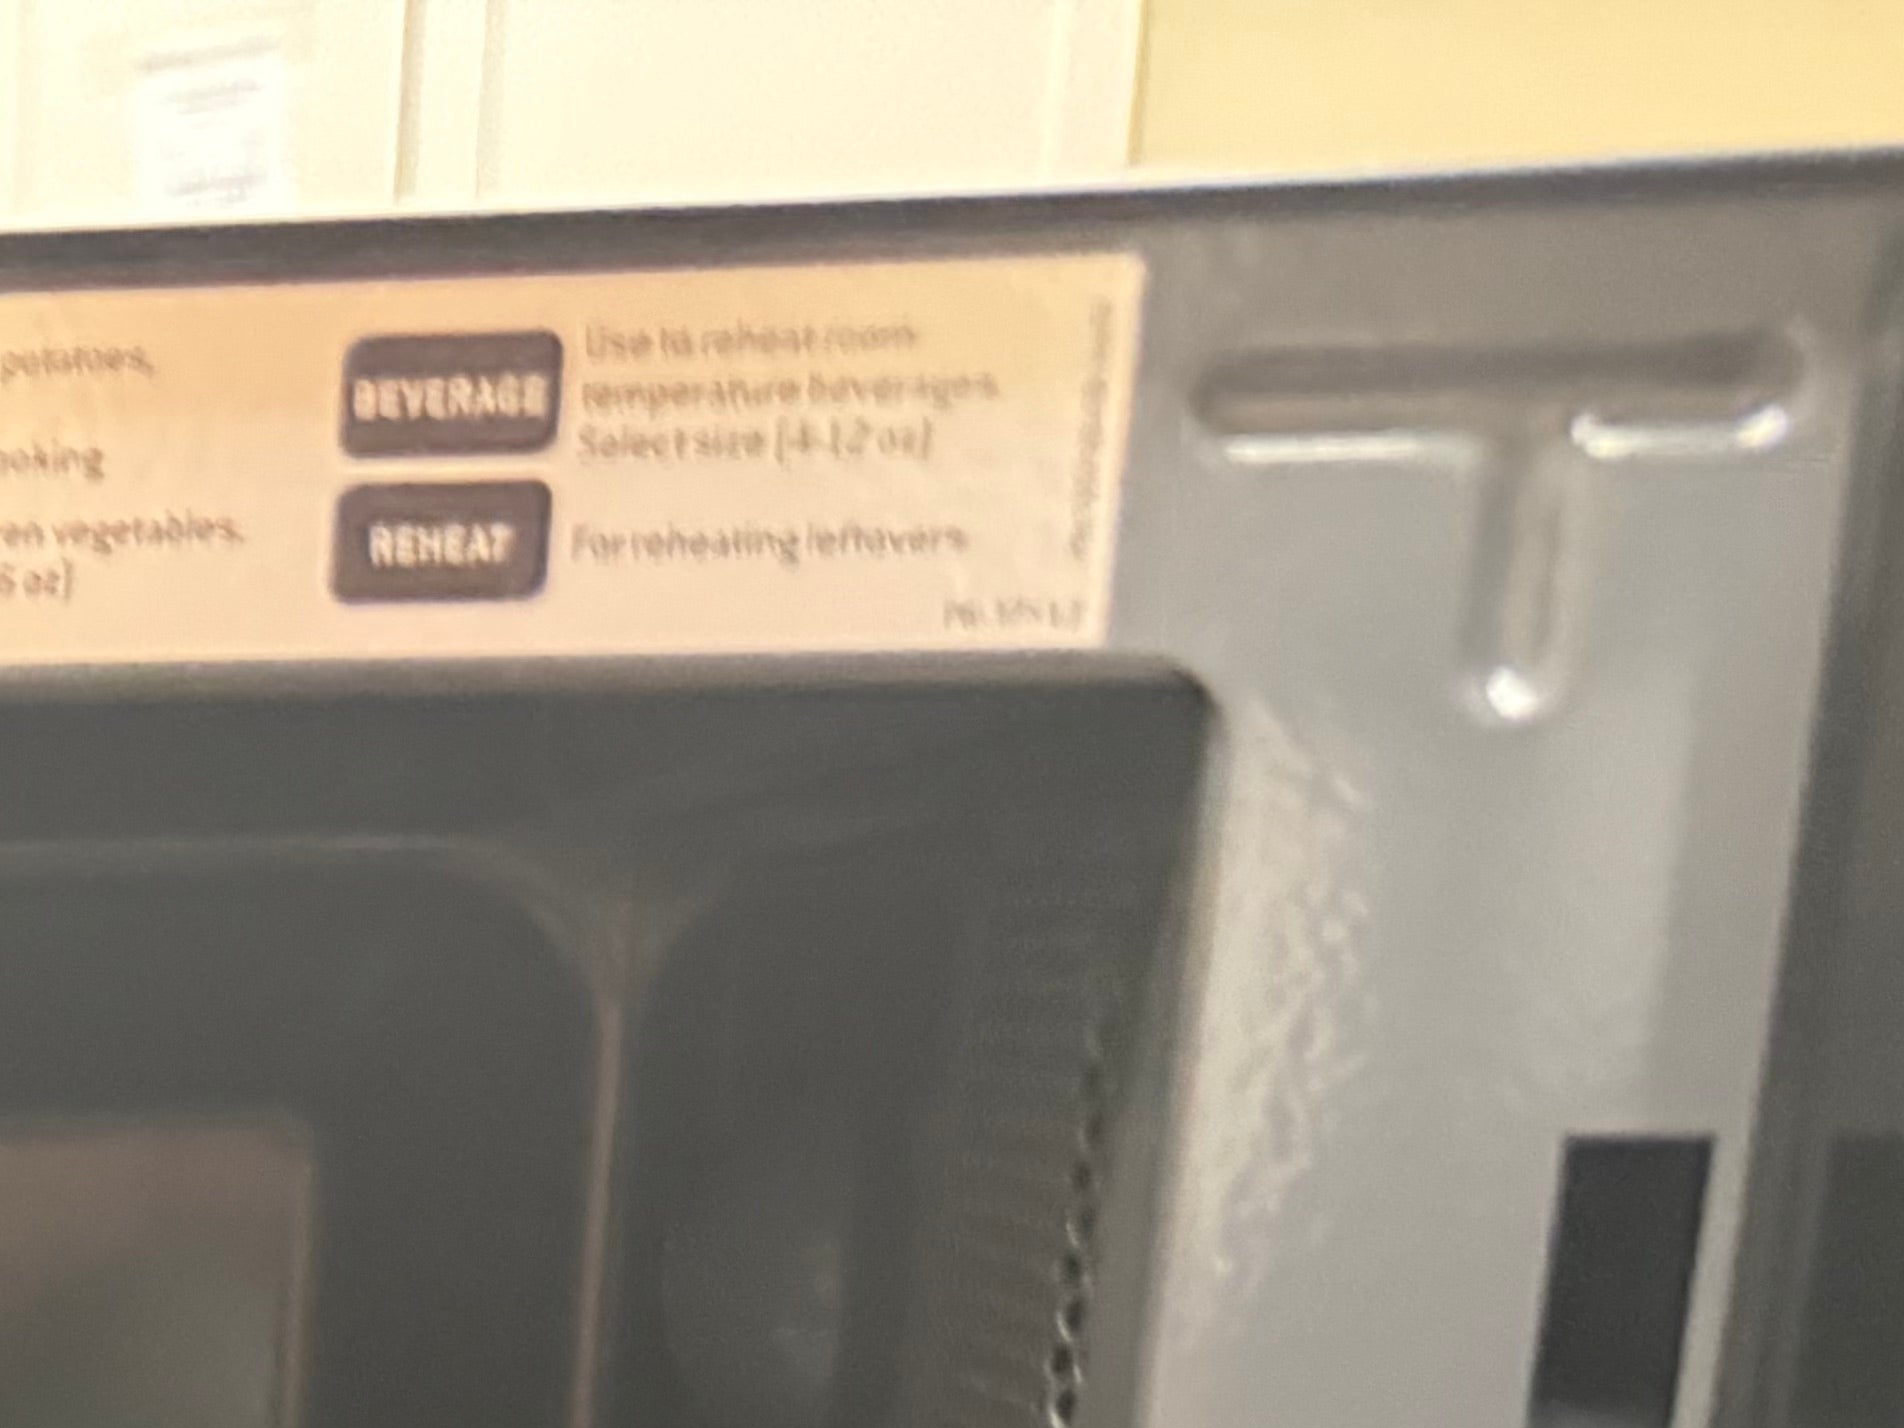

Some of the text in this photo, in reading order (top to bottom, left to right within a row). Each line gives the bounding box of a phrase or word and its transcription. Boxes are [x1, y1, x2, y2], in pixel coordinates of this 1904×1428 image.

[352, 370, 548, 422] BEVERAGE
[583, 376, 800, 418] temperature
[580, 425, 686, 460] Select
[691, 425, 766, 459] size
[369, 521, 516, 568] REHEAT
[571, 523, 626, 562] For
[630, 520, 800, 570] reheating
